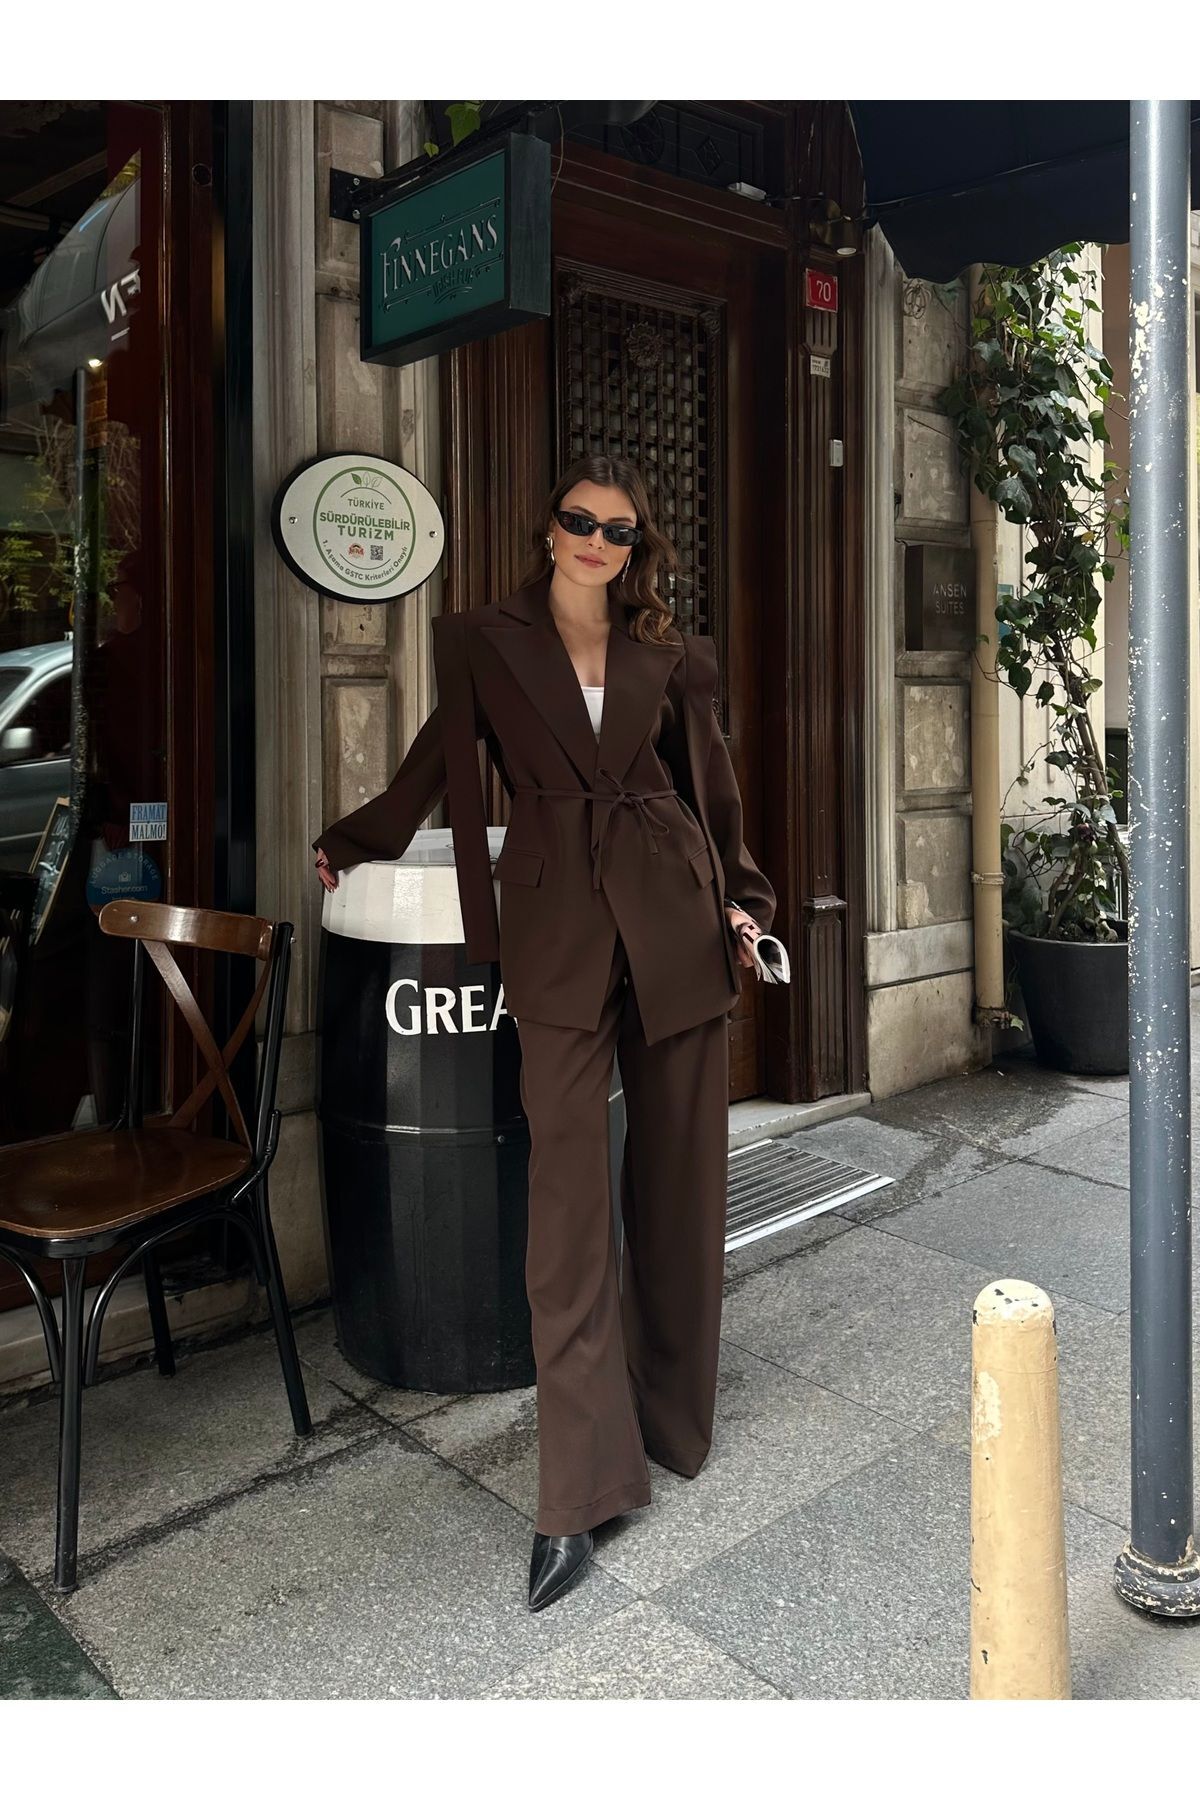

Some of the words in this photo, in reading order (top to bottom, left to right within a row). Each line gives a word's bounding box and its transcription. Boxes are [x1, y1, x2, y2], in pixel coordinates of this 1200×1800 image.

[380, 214, 498, 298] FINNEGANS
[816, 280, 832, 302] 70
[347, 497, 385, 510] TÜRKİYE
[344, 568, 364, 580] GSTC
[364, 566, 395, 581] Kriterleri
[933, 583, 967, 598] ANSEN
[935, 601, 965, 614] SUITES
